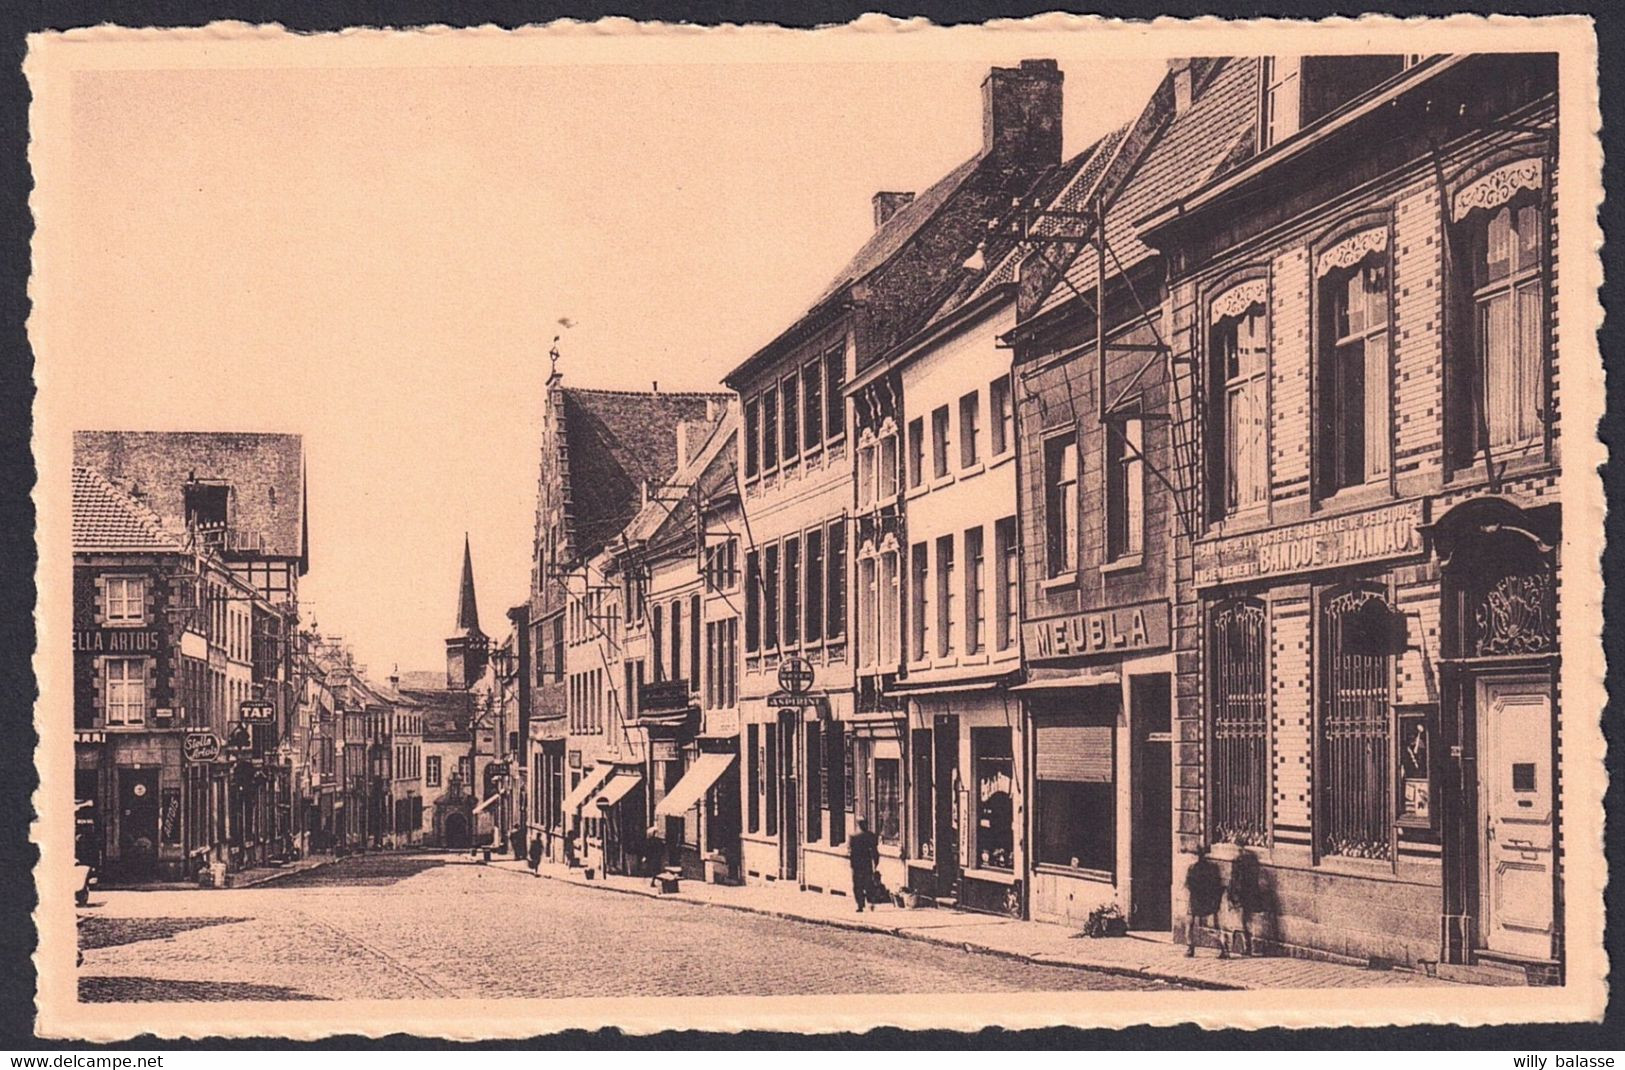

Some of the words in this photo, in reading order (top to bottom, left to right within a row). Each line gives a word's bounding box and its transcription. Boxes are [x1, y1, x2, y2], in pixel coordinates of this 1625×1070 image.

[1259, 534, 1323, 575] BANQUE
[1343, 519, 1420, 562] HAINAUT
[109, 631, 159, 651] ARTOIS
[1034, 609, 1149, 657] MEUBLA
[185, 734, 213, 750] Stella
[163, 797, 179, 838] ARTOIS
